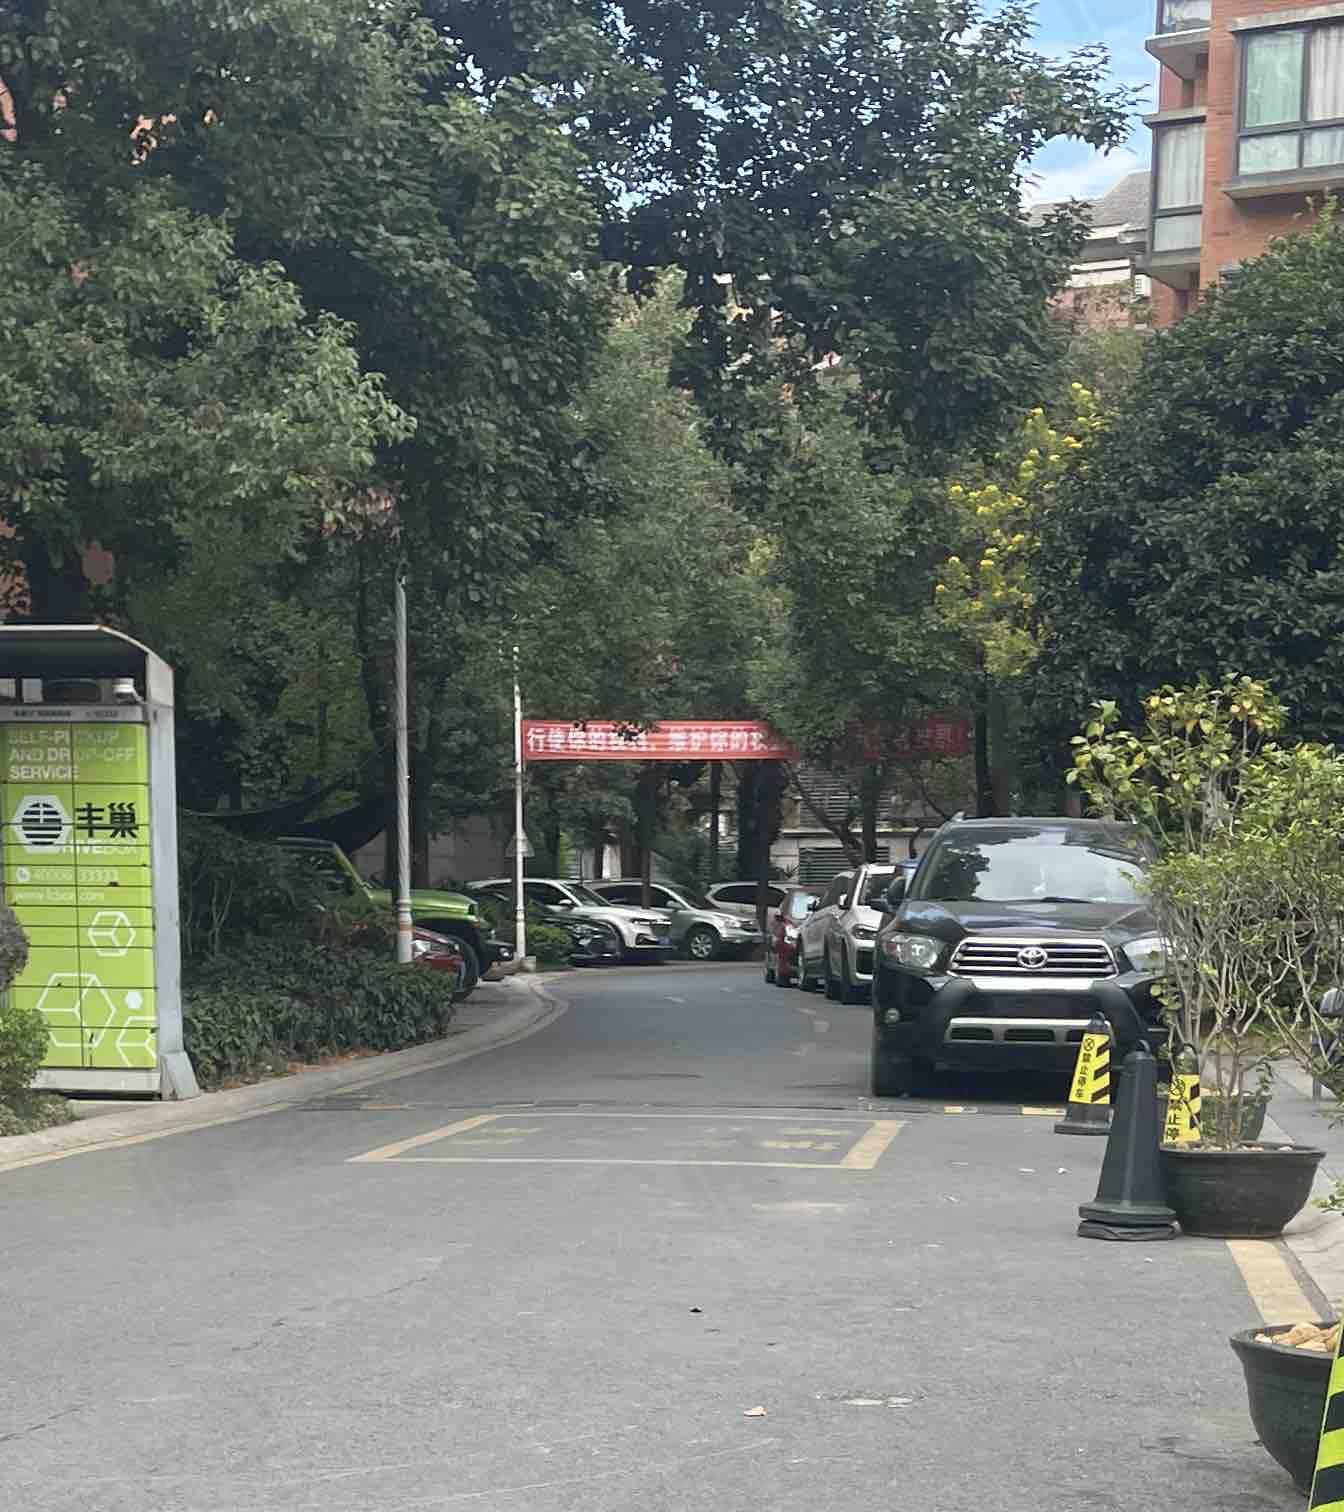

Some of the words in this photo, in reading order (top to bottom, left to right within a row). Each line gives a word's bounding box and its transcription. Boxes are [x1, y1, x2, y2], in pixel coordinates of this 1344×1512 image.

[8, 747, 44, 762] AND
[8, 764, 81, 780] SERVICE
[76, 802, 140, 838] 丰巢
